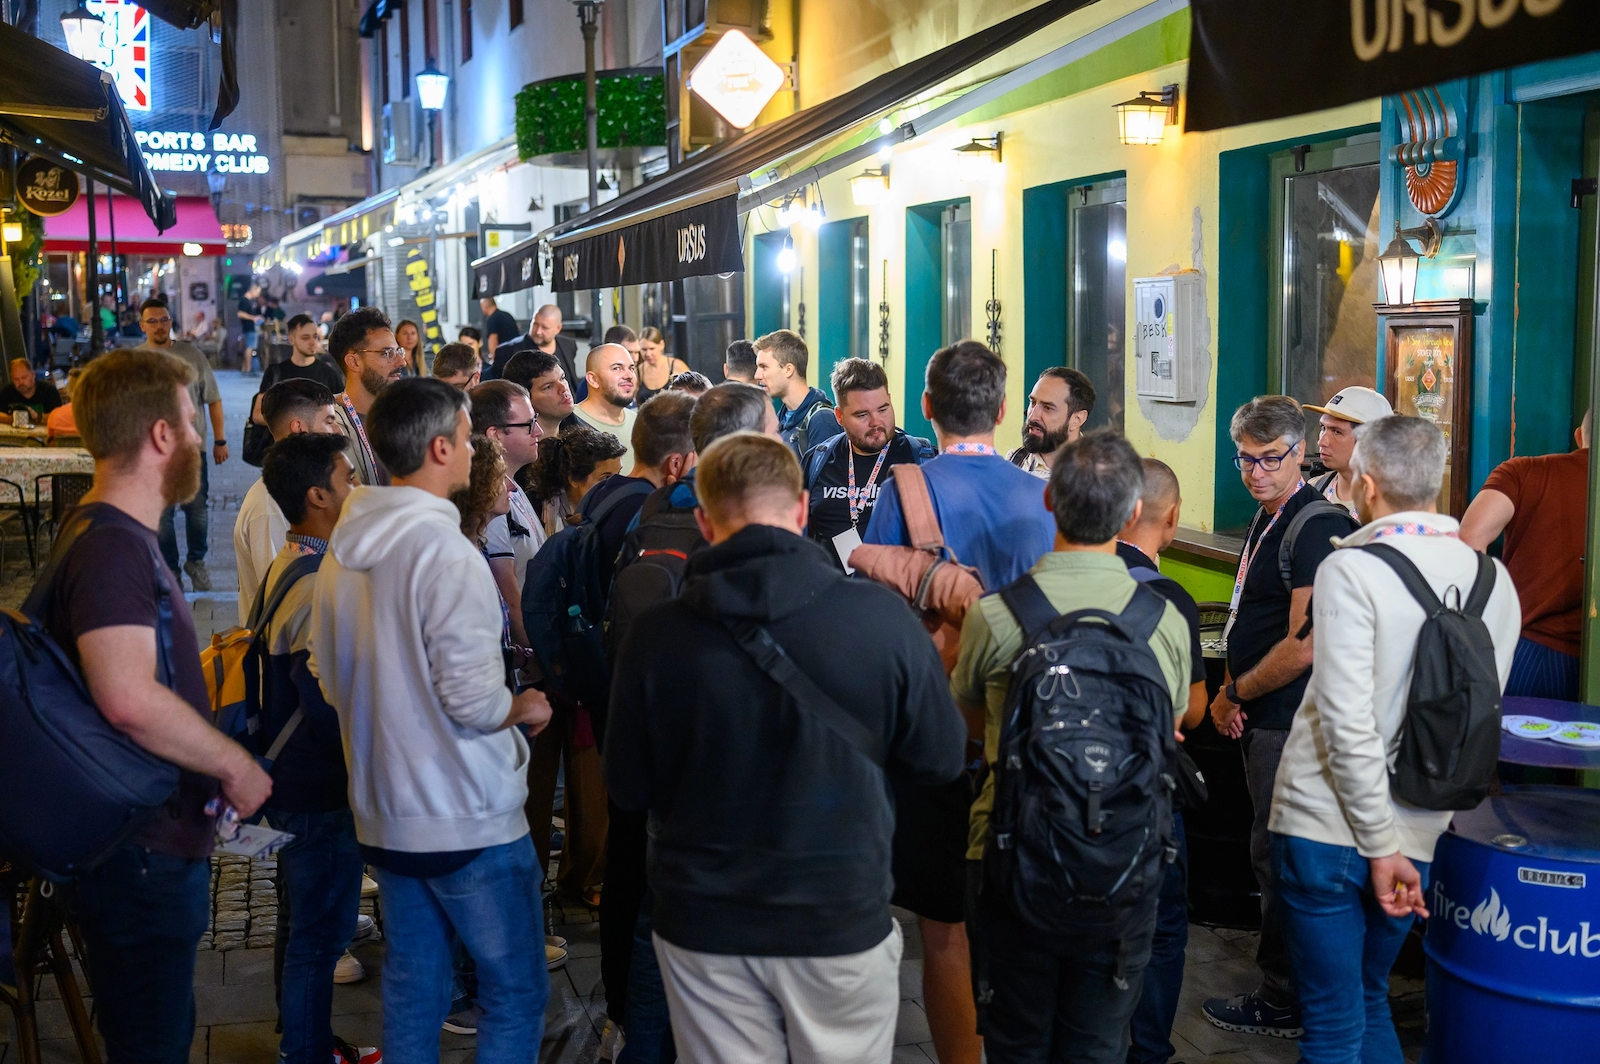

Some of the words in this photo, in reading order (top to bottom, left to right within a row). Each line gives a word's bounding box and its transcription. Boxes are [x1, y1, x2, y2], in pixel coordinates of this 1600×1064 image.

[1350, 0, 1564, 62] URS
[134, 130, 206, 151] PORTS
[212, 132, 257, 153] BAR
[142, 151, 212, 172] OMEDY
[214, 153, 270, 174] CLUB
[25, 184, 70, 203] Kozel
[677, 223, 706, 264] URSUS
[1433, 880, 1470, 930] fire
[1513, 916, 1600, 958] club
